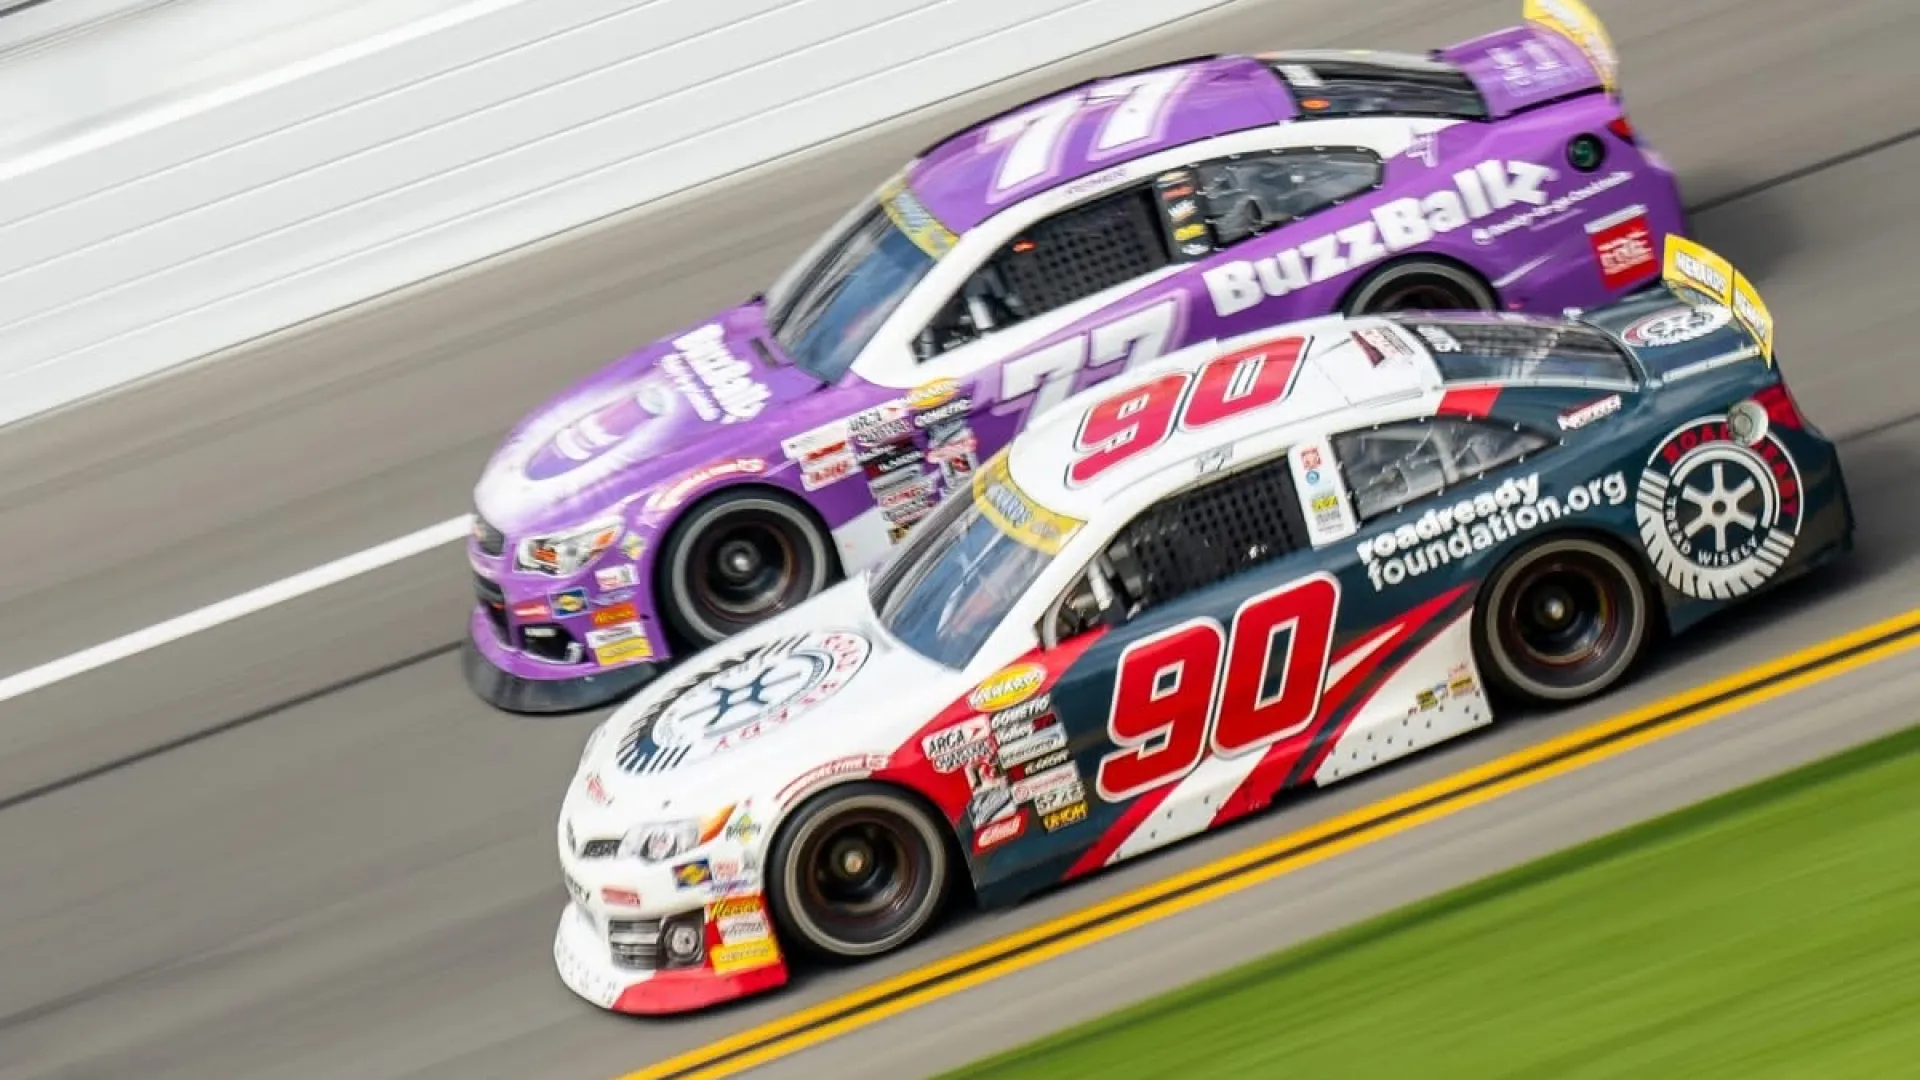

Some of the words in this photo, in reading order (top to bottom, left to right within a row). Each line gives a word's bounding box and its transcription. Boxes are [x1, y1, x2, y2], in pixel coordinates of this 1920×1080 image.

[985, 66, 1191, 191] 77
[1002, 299, 1179, 424] 77
[1066, 335, 1312, 488] 90
[1356, 472, 1540, 564] roadready
[1367, 470, 1628, 592] foundation.org
[1665, 496, 1692, 554] TREAD
[1698, 534, 1759, 566] WISELY
[928, 729, 966, 757] ARCA
[1096, 571, 1341, 803] 90
